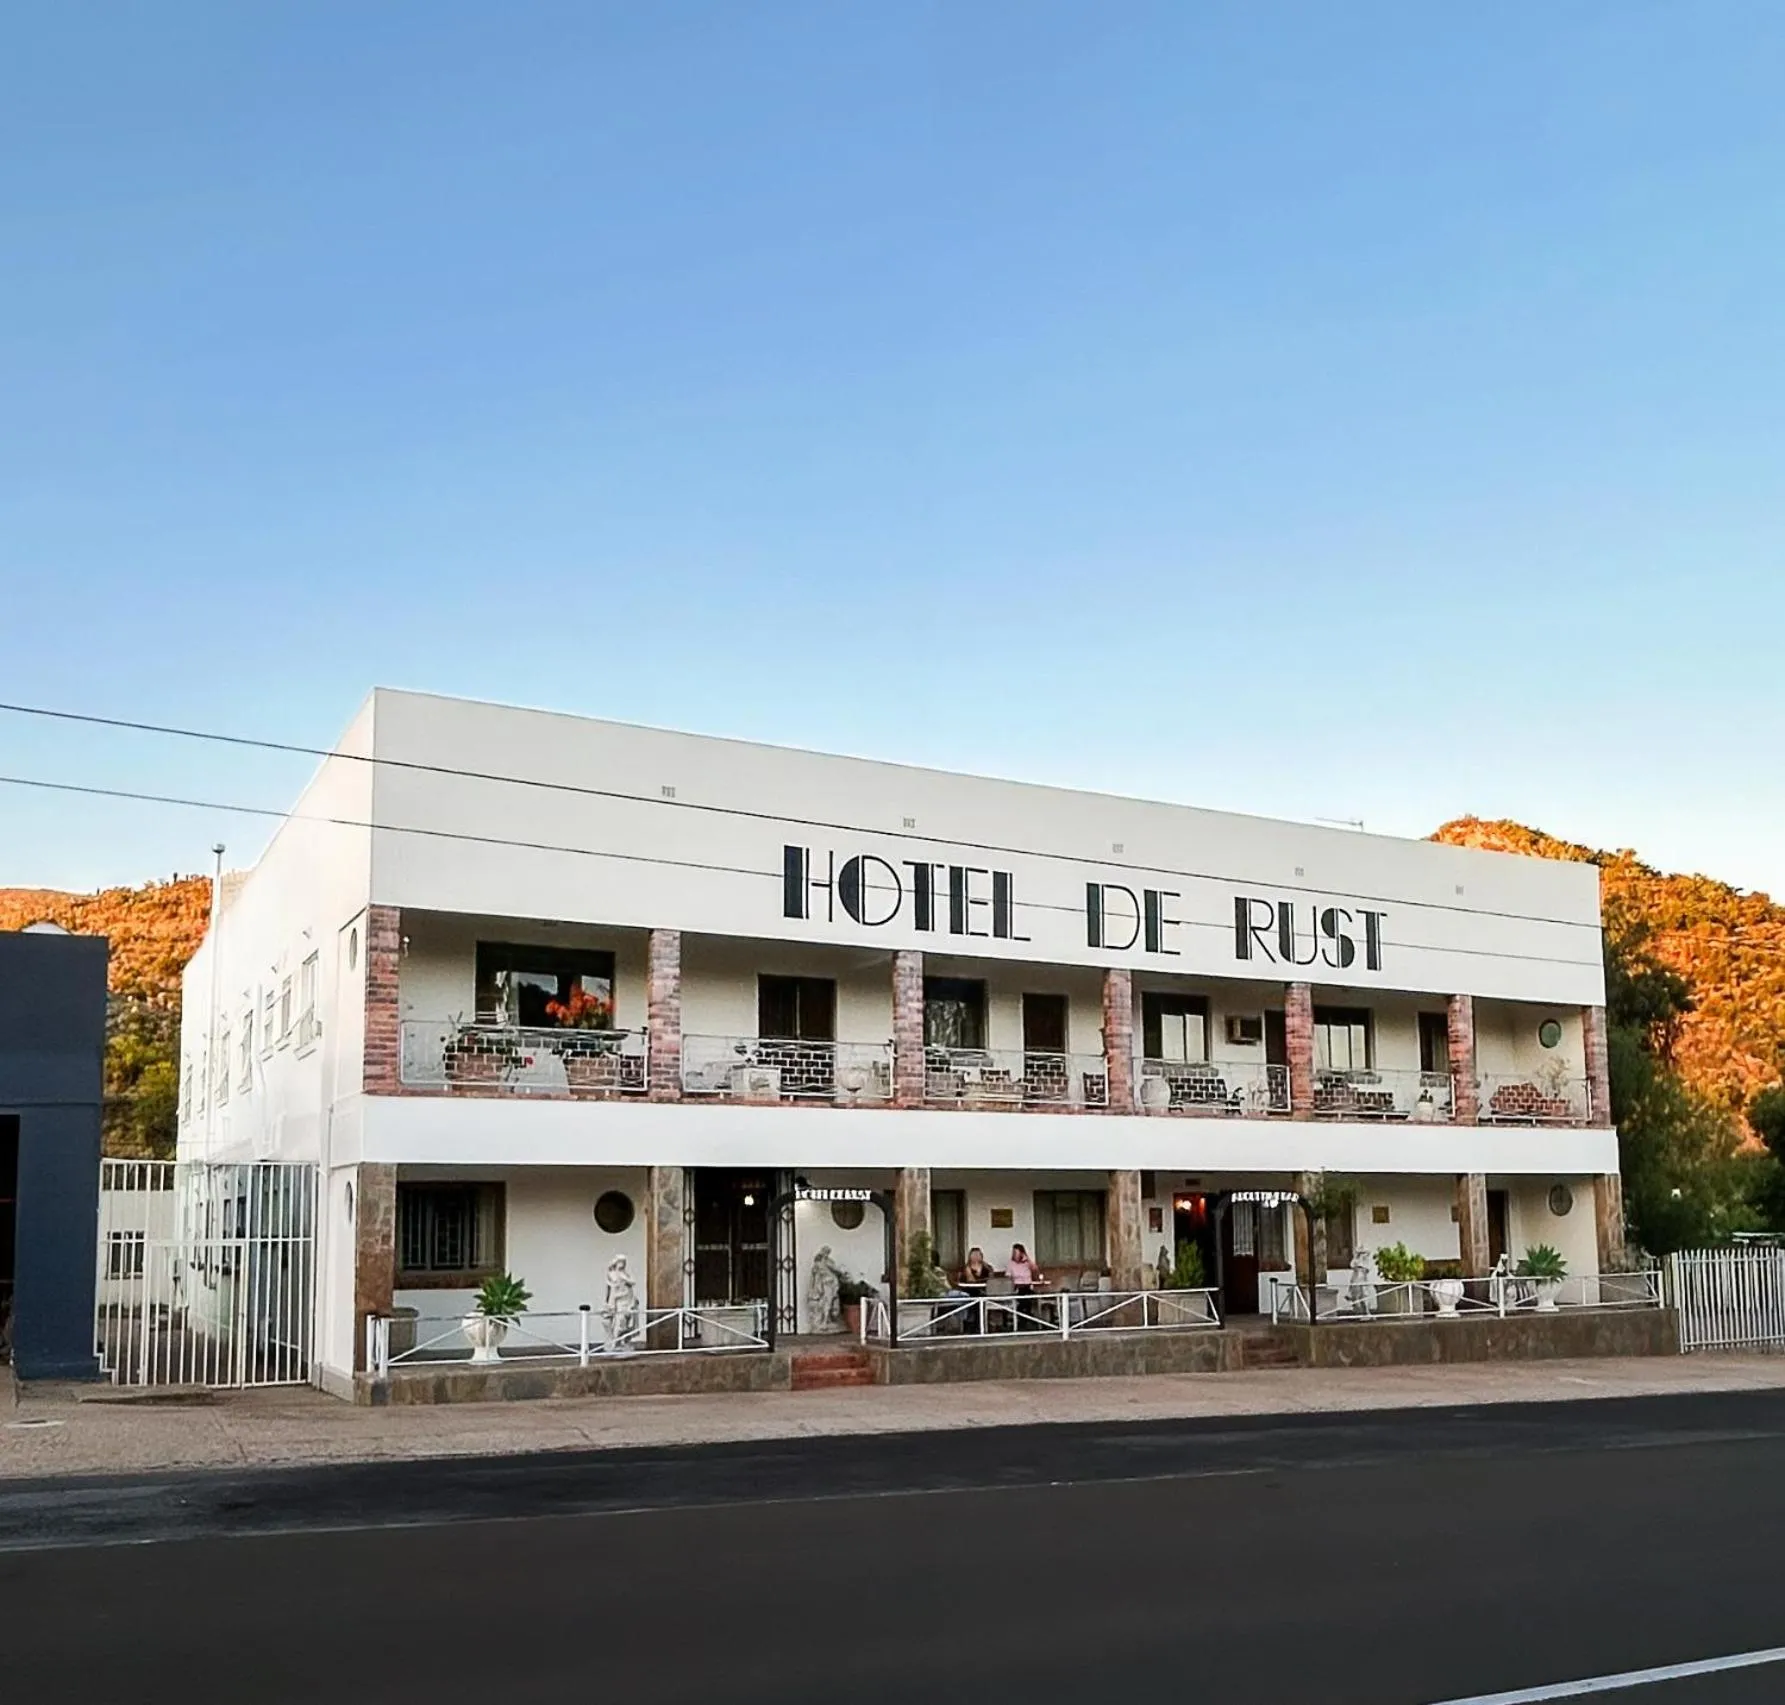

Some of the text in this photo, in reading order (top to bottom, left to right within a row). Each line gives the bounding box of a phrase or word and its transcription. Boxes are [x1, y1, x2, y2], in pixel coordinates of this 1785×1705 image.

[783, 844, 1387, 971] HOTEL DE RUST
